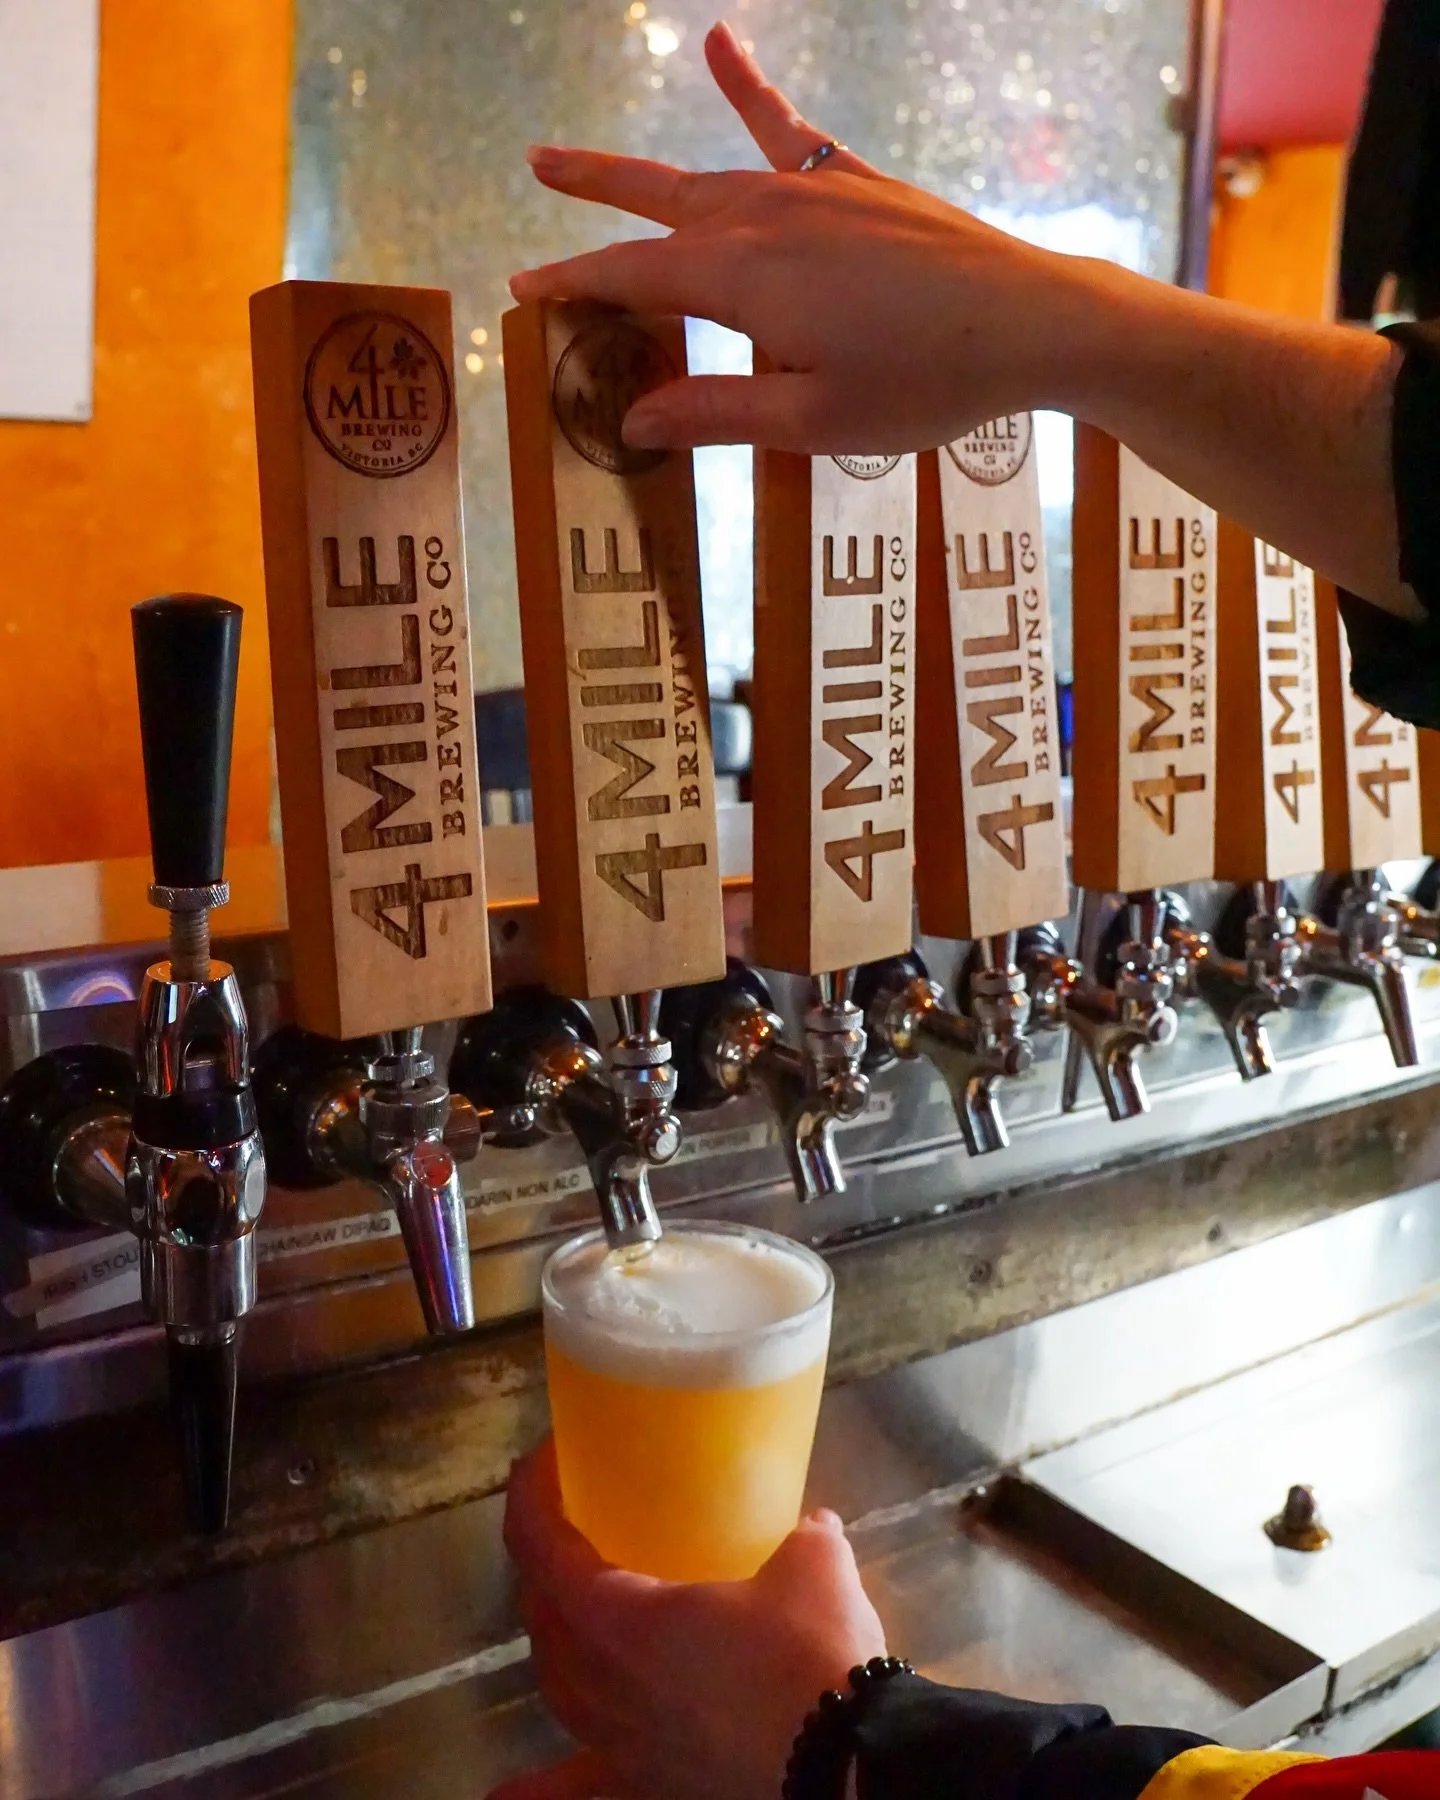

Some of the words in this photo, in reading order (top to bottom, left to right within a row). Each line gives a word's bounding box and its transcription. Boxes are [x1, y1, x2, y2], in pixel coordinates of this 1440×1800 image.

[326, 384, 429, 421] MILE
[341, 423, 422, 437] BREWING
[371, 439, 392, 452] CO
[974, 413, 1018, 439] ILE
[341, 443, 404, 467] VICTORIA
[842, 455, 882, 471] ICTORIA
[424, 536, 451, 590] CO
[890, 536, 907, 582] CO
[1019, 532, 1037, 573] CO
[1190, 572, 1207, 745] BREWING
[889, 596, 907, 799] BREWING
[1023, 586, 1050, 774] BREWING
[429, 605, 466, 839] BREWING
[92, 1248, 139, 1279] STOU
